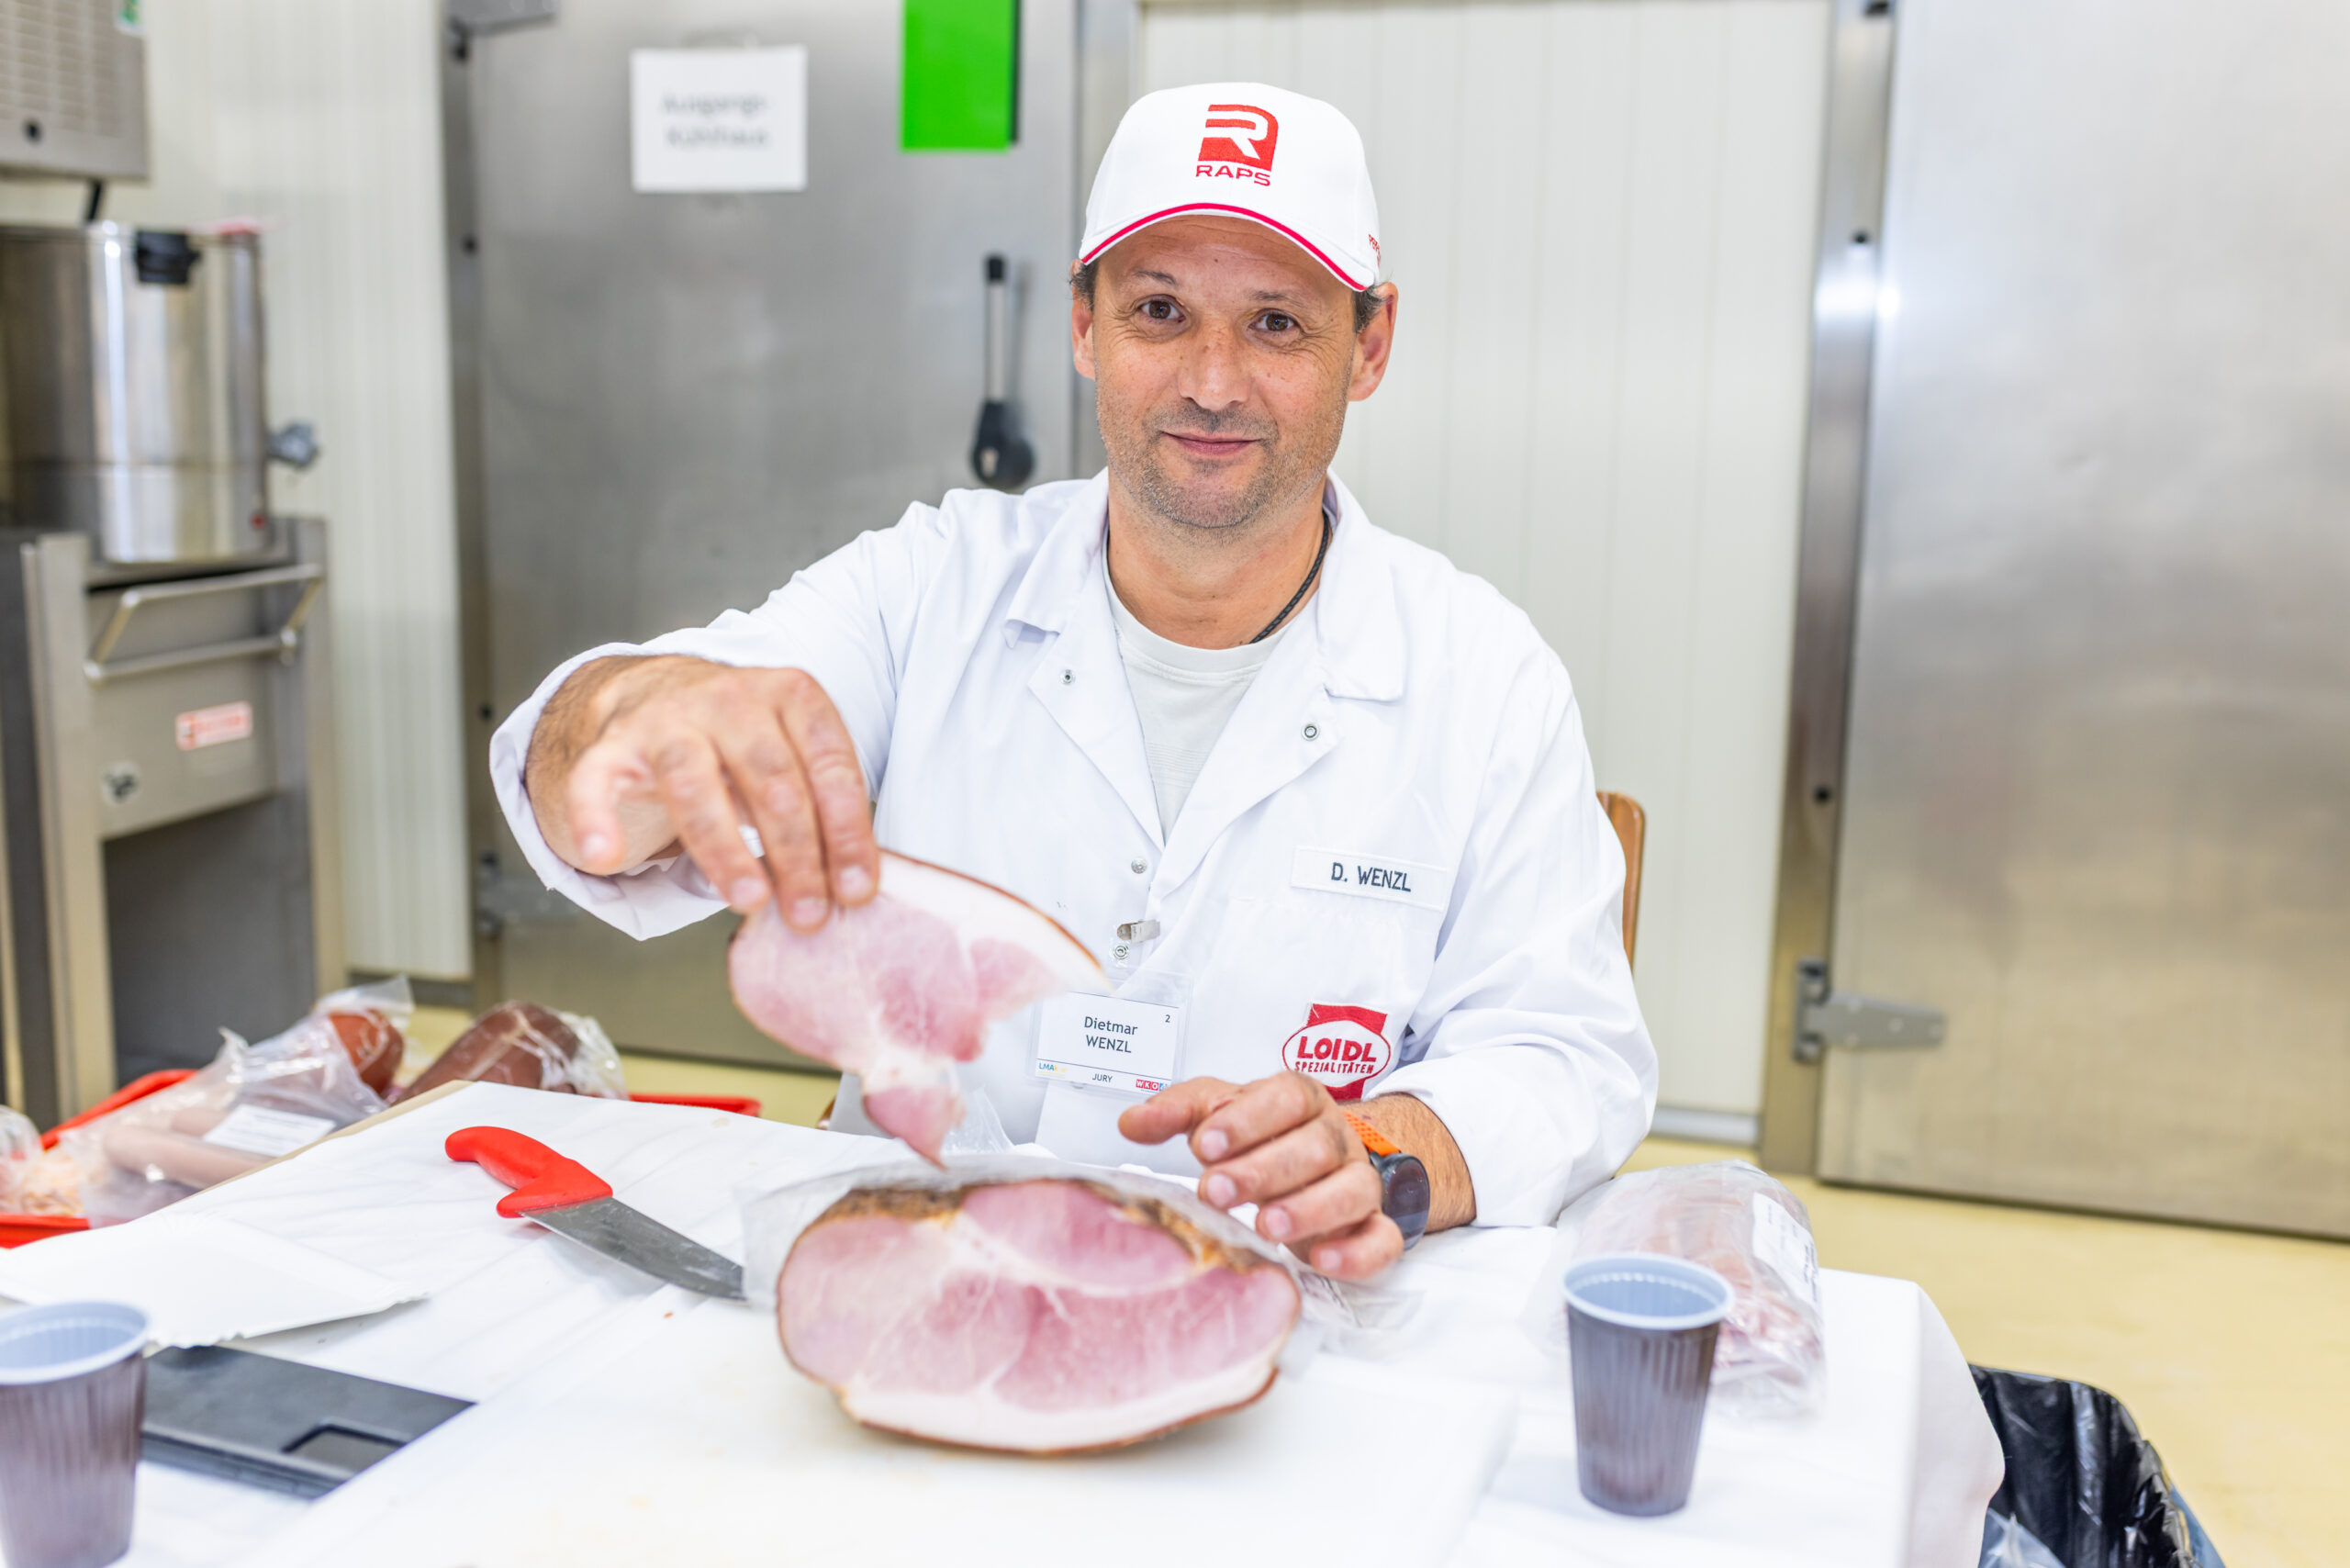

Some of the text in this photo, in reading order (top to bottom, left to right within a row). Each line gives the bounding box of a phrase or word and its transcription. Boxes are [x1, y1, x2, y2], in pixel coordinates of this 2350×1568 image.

[1196, 164, 1271, 186] RAPS
[1331, 861, 1412, 892] D. WENZL
[1083, 1016, 1138, 1036] Dietmar
[1164, 1014, 1171, 1024] 2
[1086, 1035, 1132, 1054] WENZL
[1296, 1036, 1377, 1062] LOIDL
[1295, 1061, 1374, 1074] SPEZIALITÄTEN
[1091, 1073, 1113, 1083] JURY
[1136, 1080, 1159, 1091] WKO
